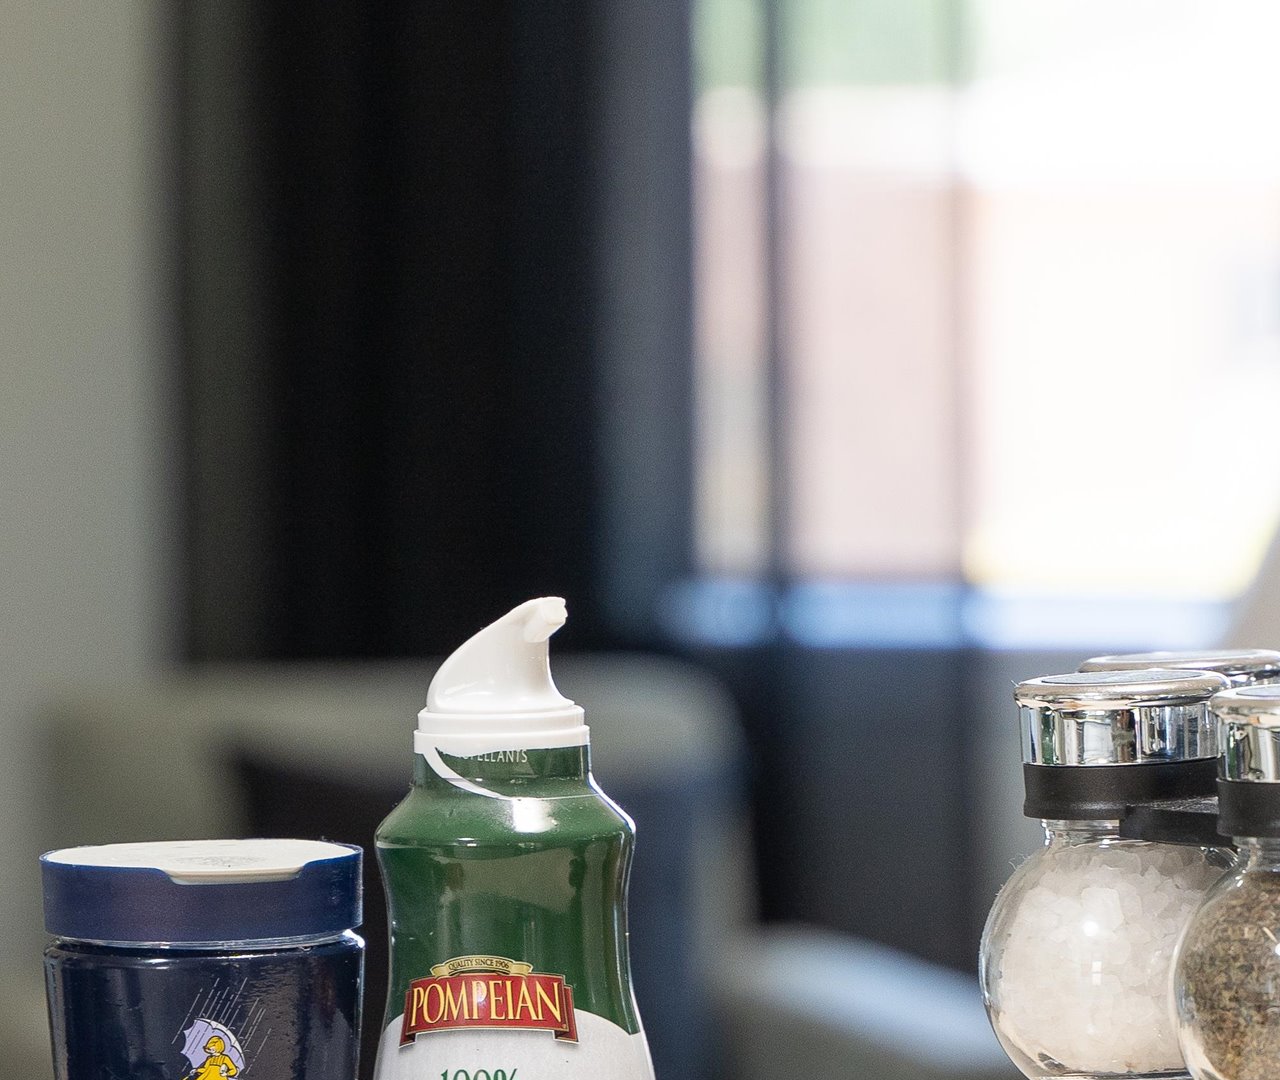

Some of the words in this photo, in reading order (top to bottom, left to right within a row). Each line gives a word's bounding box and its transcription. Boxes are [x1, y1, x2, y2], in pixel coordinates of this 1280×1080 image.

[448, 959, 474, 971] QUALITY
[475, 958, 494, 967] SINCE
[495, 959, 510, 969] 1906
[410, 979, 563, 1027] POMPEIAN
